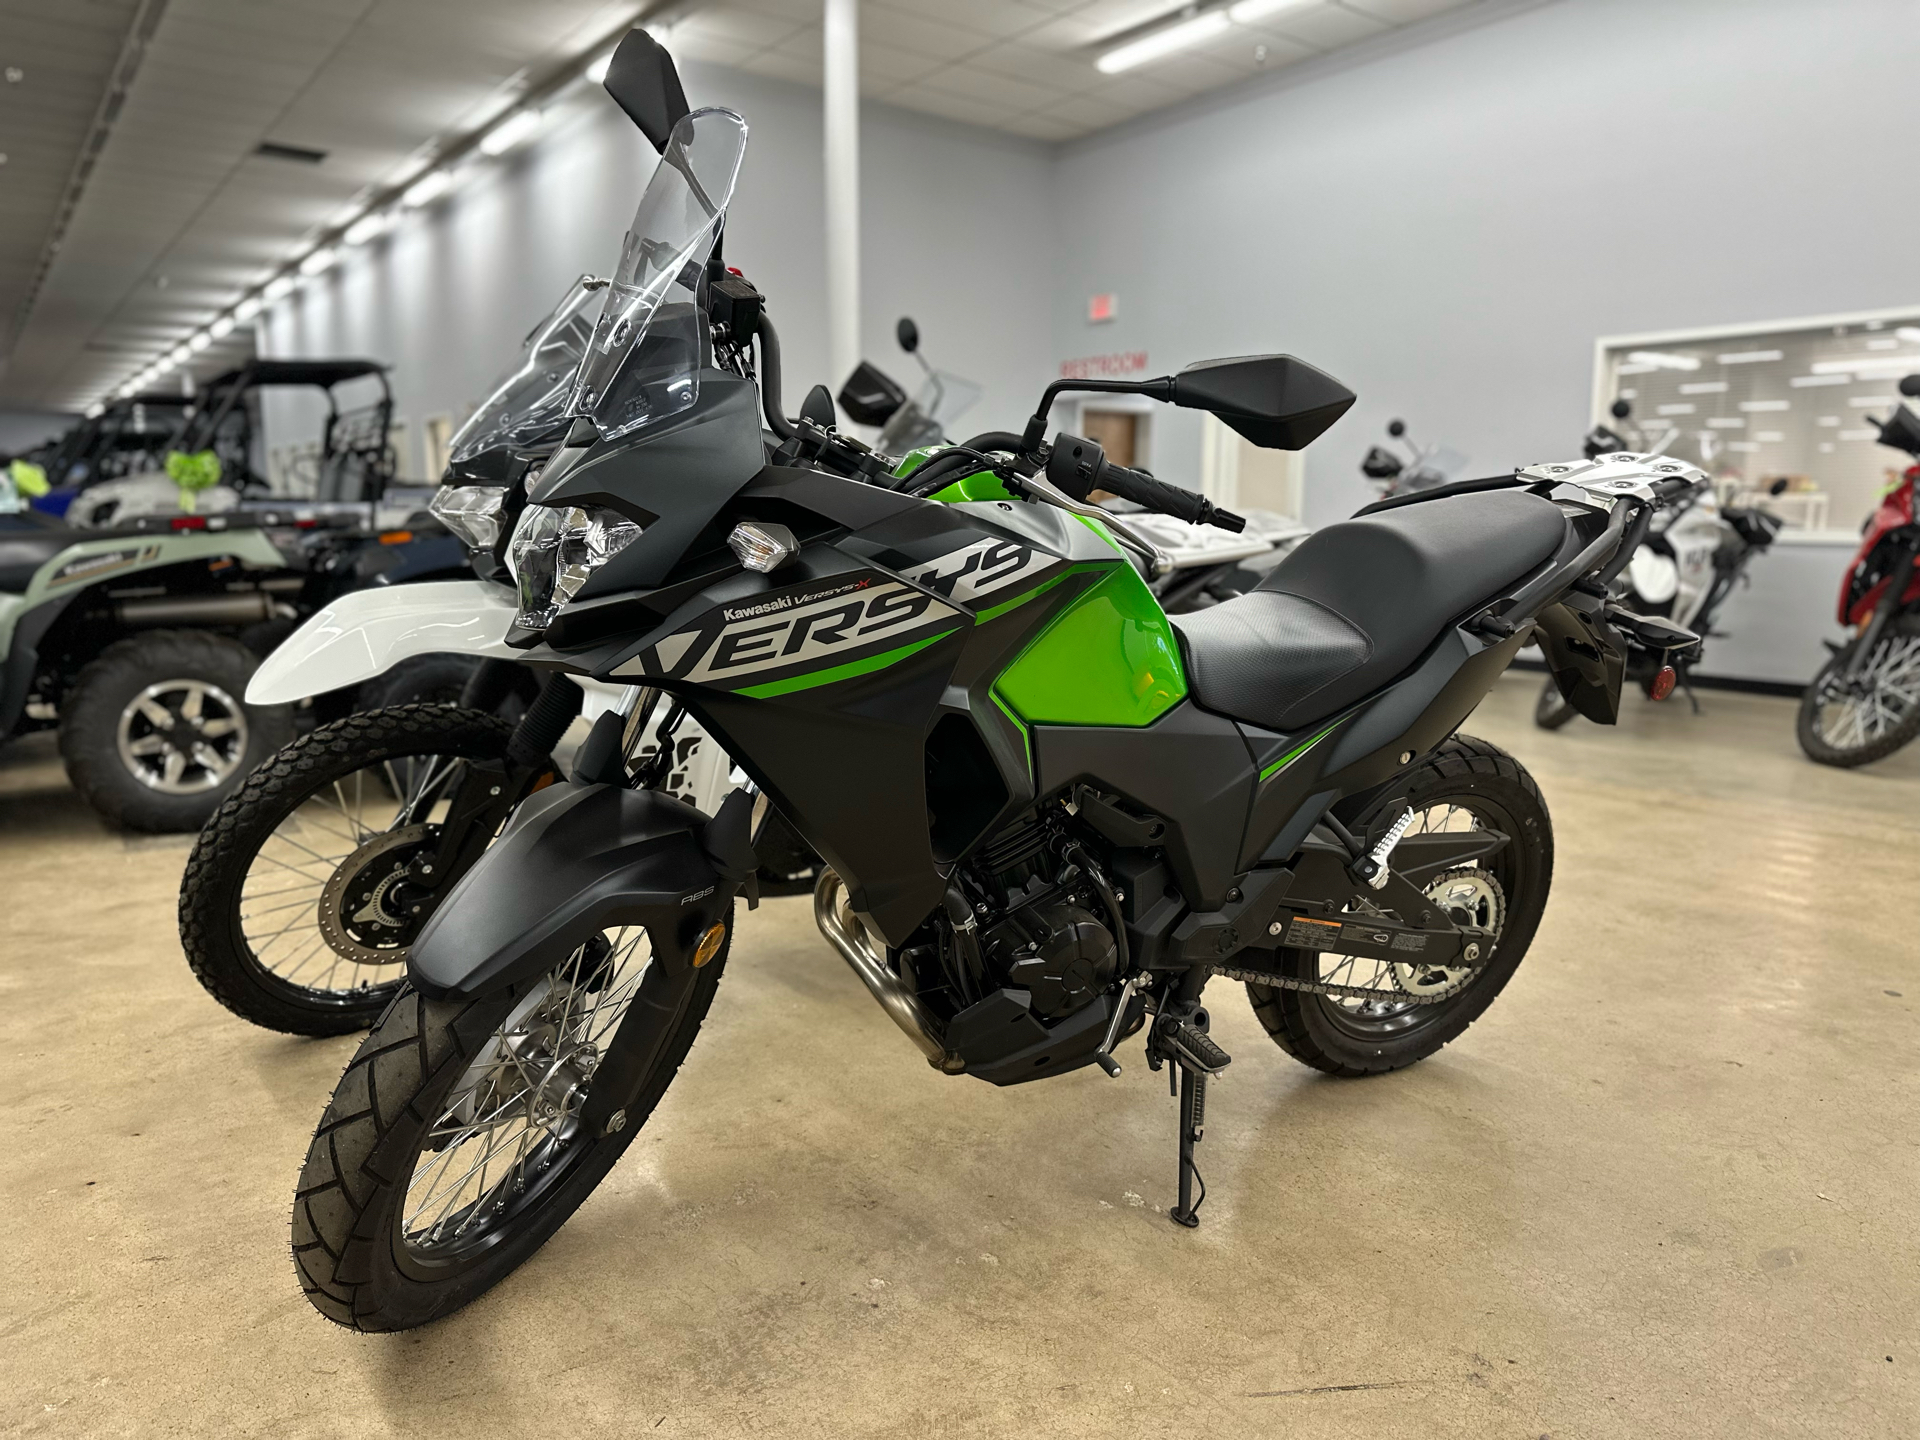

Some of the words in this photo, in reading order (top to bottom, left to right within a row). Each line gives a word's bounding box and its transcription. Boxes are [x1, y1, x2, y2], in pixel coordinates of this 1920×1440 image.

[638, 541, 1033, 681] VERSYS
[723, 595, 792, 621] Kawasaki
[794, 577, 872, 605] VERSYS-X
[680, 885, 715, 906] ABS
